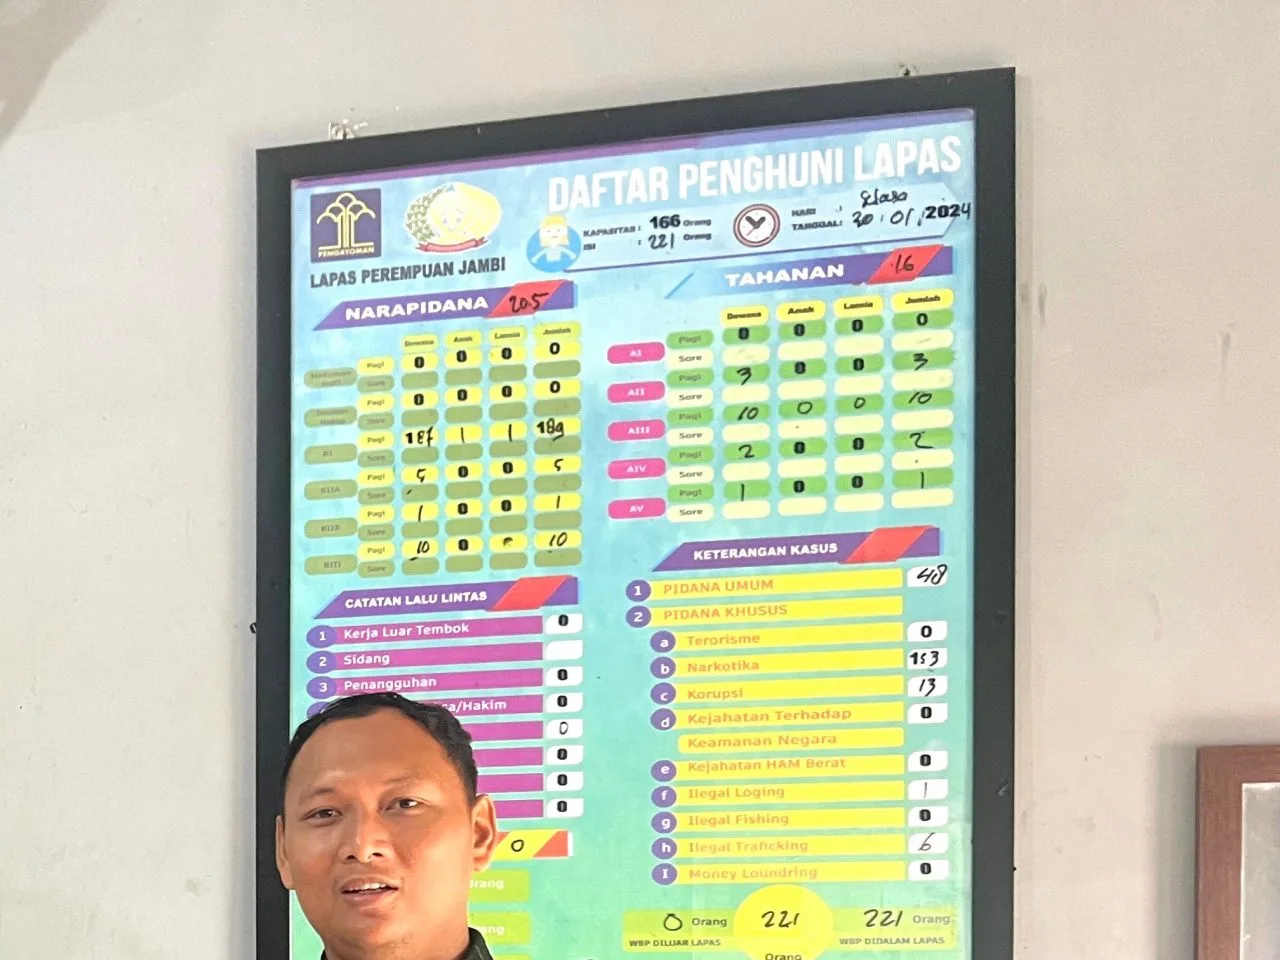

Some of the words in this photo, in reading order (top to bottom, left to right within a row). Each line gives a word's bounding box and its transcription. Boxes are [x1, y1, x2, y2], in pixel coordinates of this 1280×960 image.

[549, 164, 669, 213] DAFTAR
[679, 147, 843, 201] PENGHUNI
[853, 135, 962, 182] LAPAS
[649, 214, 681, 229] 166
[310, 270, 357, 288] LAPAS
[361, 261, 454, 284] PEREMPUAN
[458, 256, 506, 275] JAMBI
[725, 264, 844, 287] TAHANAN
[345, 296, 489, 321] NARAPIDANA
[916, 313, 928, 326] 0
[738, 406, 759, 420] 10
[797, 402, 812, 414] 0
[854, 397, 866, 409] 0
[693, 545, 787, 561] KETERANGAN
[790, 543, 838, 556] KASUS
[664, 582, 721, 594] PIDANA
[724, 579, 773, 592] UMUM
[345, 596, 401, 609] CATATAN
[405, 594, 438, 606] LALU
[441, 591, 487, 604] LINTAS
[664, 608, 721, 620] PIDANA
[724, 604, 787, 617] KHUSUS
[344, 627, 378, 640] Kerja
[383, 627, 412, 638] Luar
[416, 622, 469, 635] Tembok
[687, 633, 761, 646] Terorisme
[920, 625, 932, 638] 0
[344, 654, 390, 666] Sidang
[687, 660, 760, 672] Narkotika
[344, 677, 437, 691] Penangguhan
[687, 687, 744, 701] Korupsi
[688, 711, 769, 725] Kejahatan
[775, 709, 852, 722] Terhadap
[688, 735, 772, 748] Keamanan
[778, 733, 837, 747] Negara
[688, 760, 763, 773] Kejahatan
[766, 759, 801, 770] HAM
[806, 757, 847, 769] Berat
[688, 788, 730, 801] Ilegal
[735, 786, 785, 800] Loging
[688, 815, 730, 828] Ilegal
[735, 813, 789, 827] Fishing
[511, 839, 525, 852] 0
[689, 842, 731, 855] Ilegal
[735, 839, 808, 853] Traficking
[689, 868, 737, 881] Money
[742, 866, 818, 880] Loundring
[469, 878, 505, 890] rang
[691, 917, 727, 927] Orang
[761, 910, 800, 928] 221
[863, 909, 903, 927] 221
[912, 915, 950, 925] Orang
[913, 936, 945, 944] LAPAS
